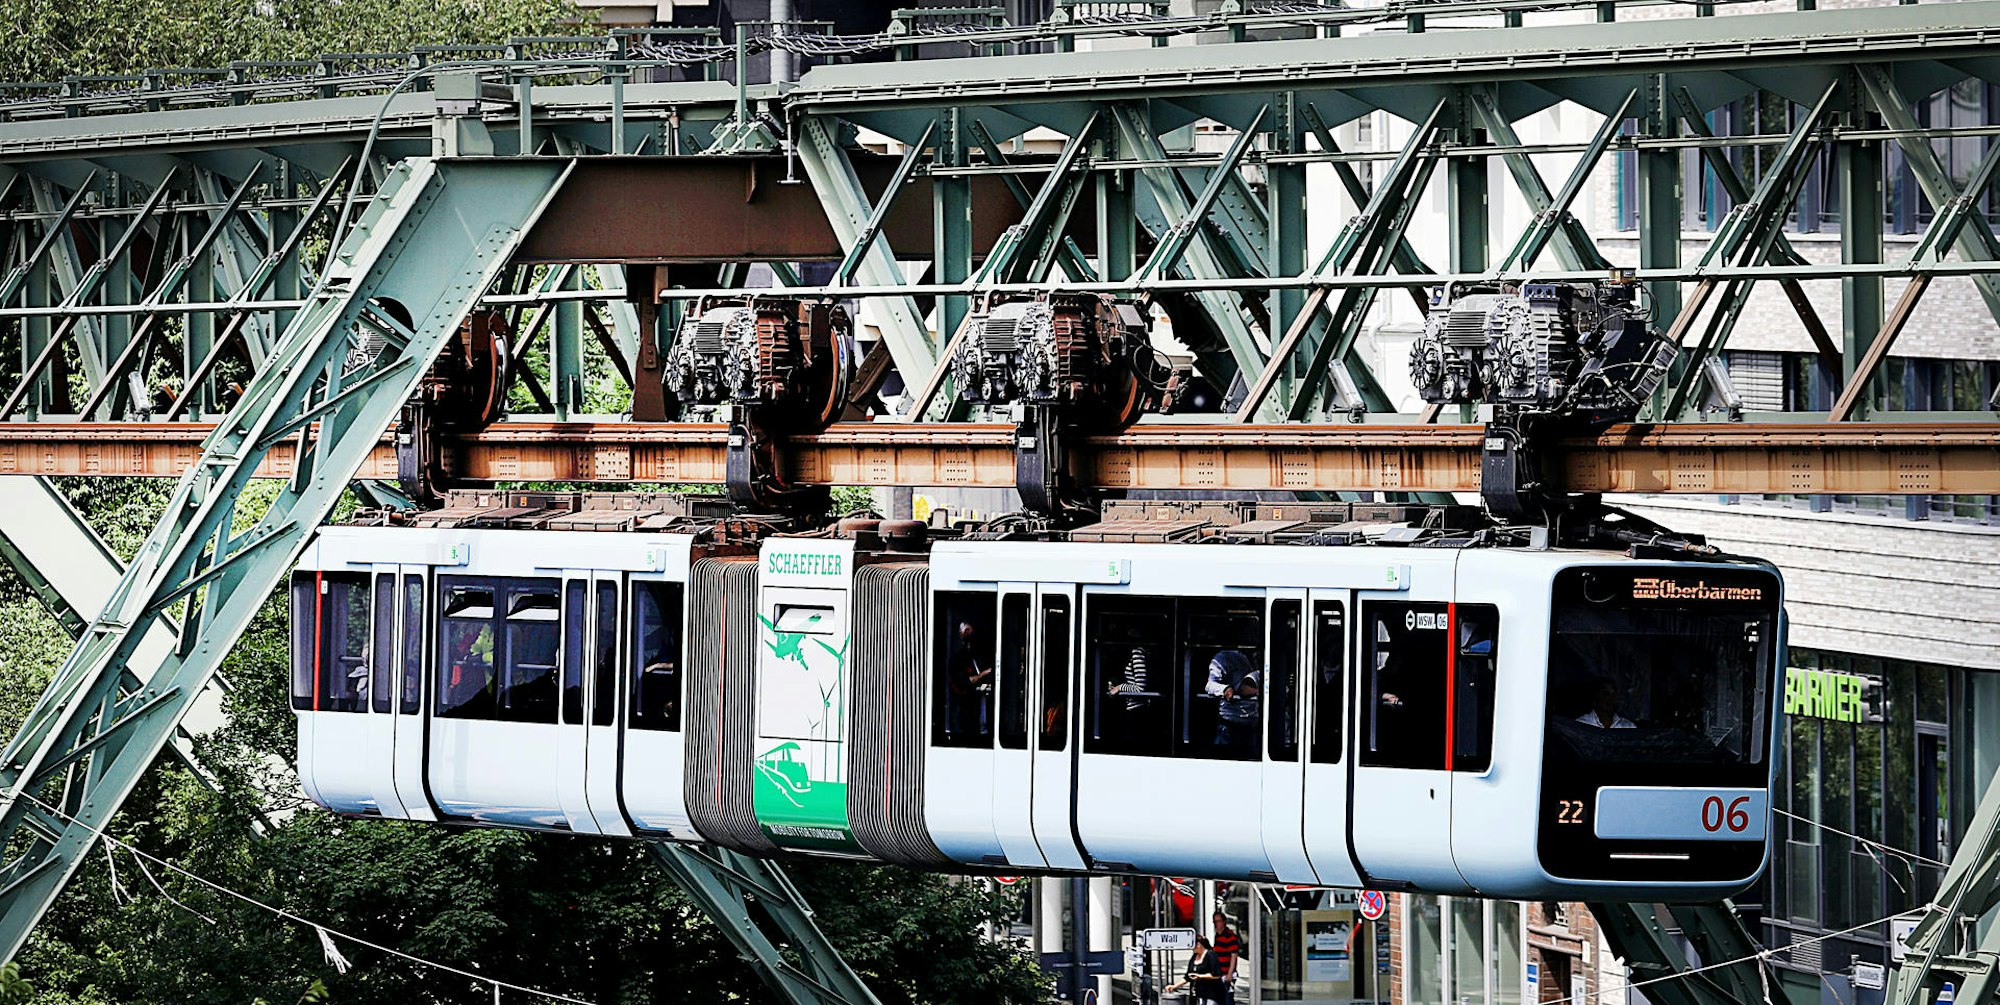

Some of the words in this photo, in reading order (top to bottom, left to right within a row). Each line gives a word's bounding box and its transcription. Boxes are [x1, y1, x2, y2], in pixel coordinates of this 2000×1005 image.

[769, 552, 842, 575] SCHAEFFLER
[1660, 580, 1761, 600] Überbarmen
[1439, 615, 1447, 627] 06
[1784, 667, 1863, 723] BARMER
[1558, 800, 1584, 824] 22
[1701, 796, 1750, 832] 06
[1160, 934, 1178, 943] Wall
